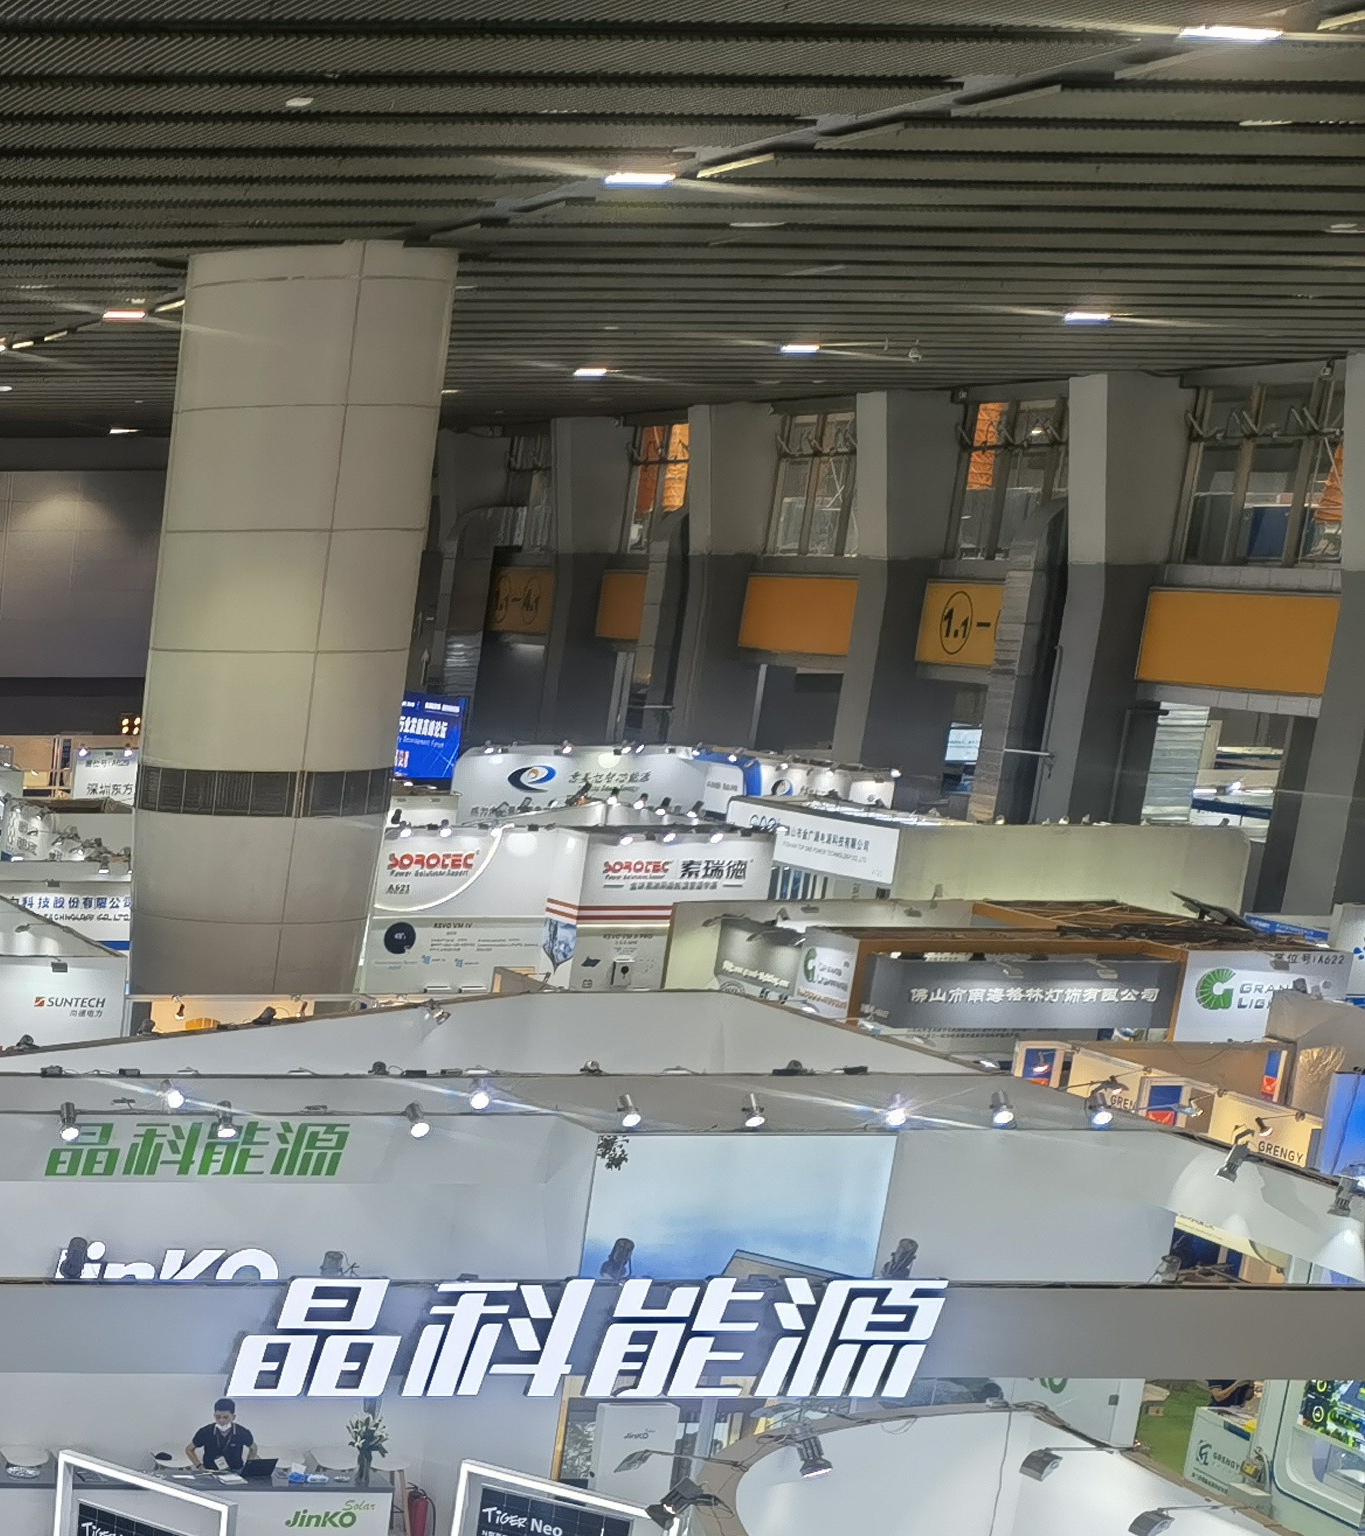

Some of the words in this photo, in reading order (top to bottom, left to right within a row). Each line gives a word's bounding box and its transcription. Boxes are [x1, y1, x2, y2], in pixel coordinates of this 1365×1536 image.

[44, 1121, 351, 1179] 晶科能源
[1257, 1140, 1304, 1162] GRENGY
[224, 1276, 950, 1399] 晶科能源
[284, 1510, 357, 1529] JinKO
